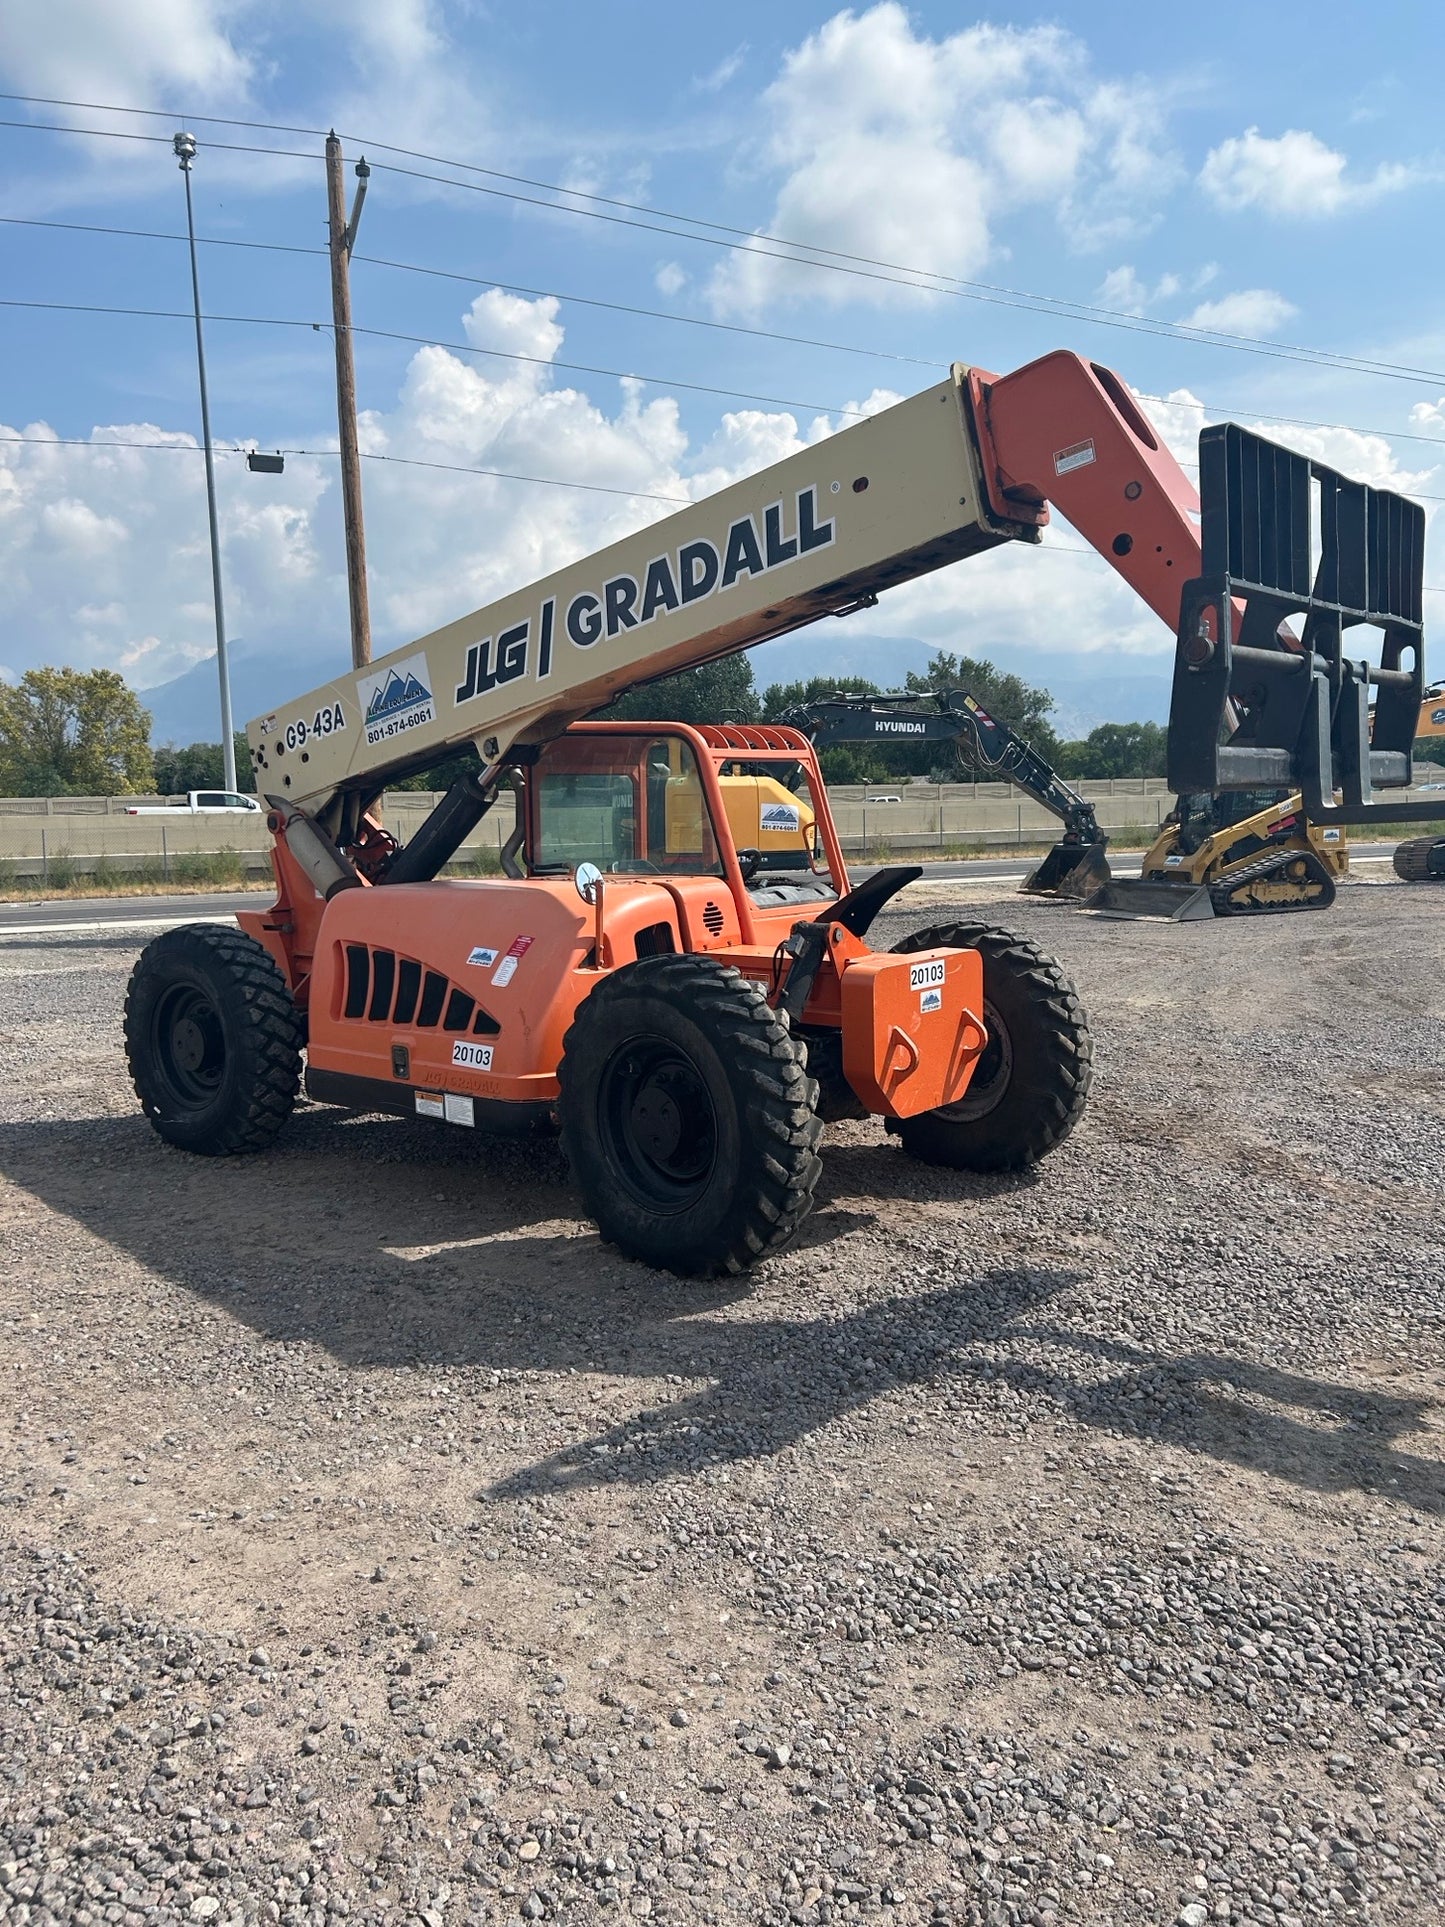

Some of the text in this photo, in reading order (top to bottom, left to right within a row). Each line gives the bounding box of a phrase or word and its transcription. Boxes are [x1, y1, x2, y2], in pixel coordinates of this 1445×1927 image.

[455, 487, 834, 706] JLG GRADALL
[367, 688, 423, 718] ALPINE EQUIPMENT
[286, 702, 345, 750] G9-43A
[367, 707, 432, 744] 801-874-6061
[875, 721, 926, 733] HYUNDAI
[911, 964, 944, 986] 20103
[453, 1045, 491, 1066] 20103
